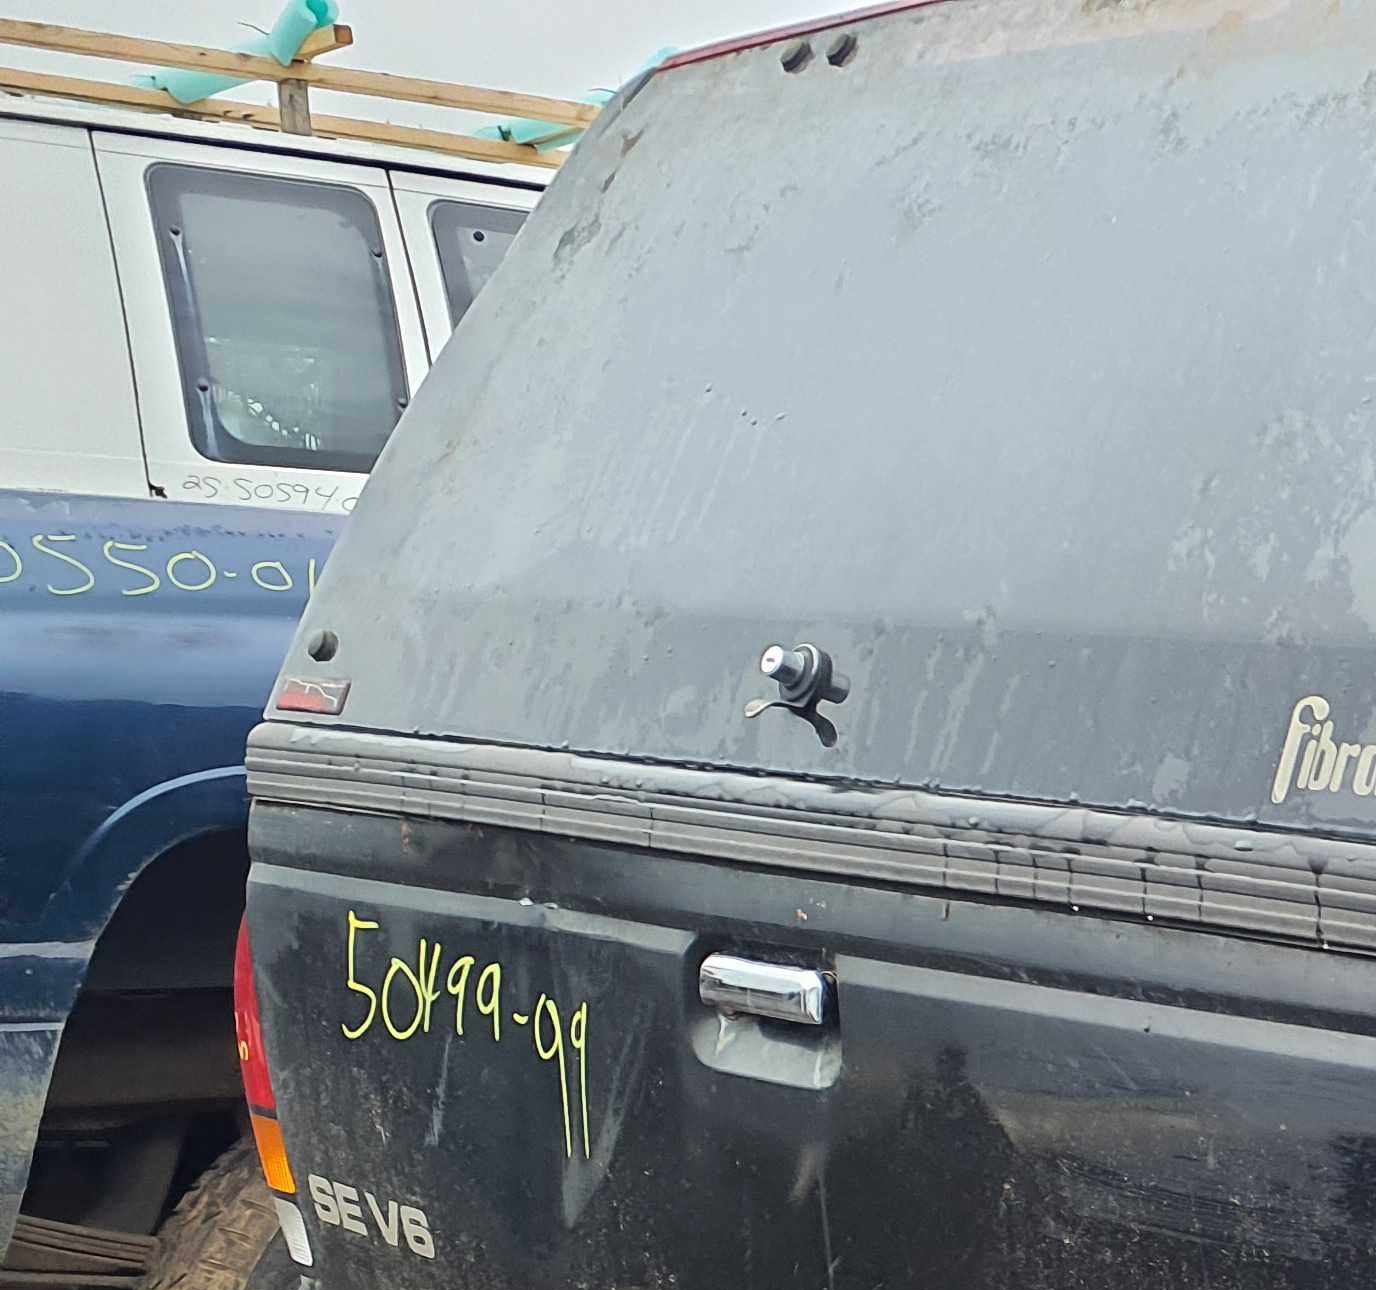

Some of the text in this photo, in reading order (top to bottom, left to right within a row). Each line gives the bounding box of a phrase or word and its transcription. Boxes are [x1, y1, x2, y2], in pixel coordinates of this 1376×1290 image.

[341, 910, 591, 1161] 50499-99
[307, 1172, 437, 1260] SE V6
